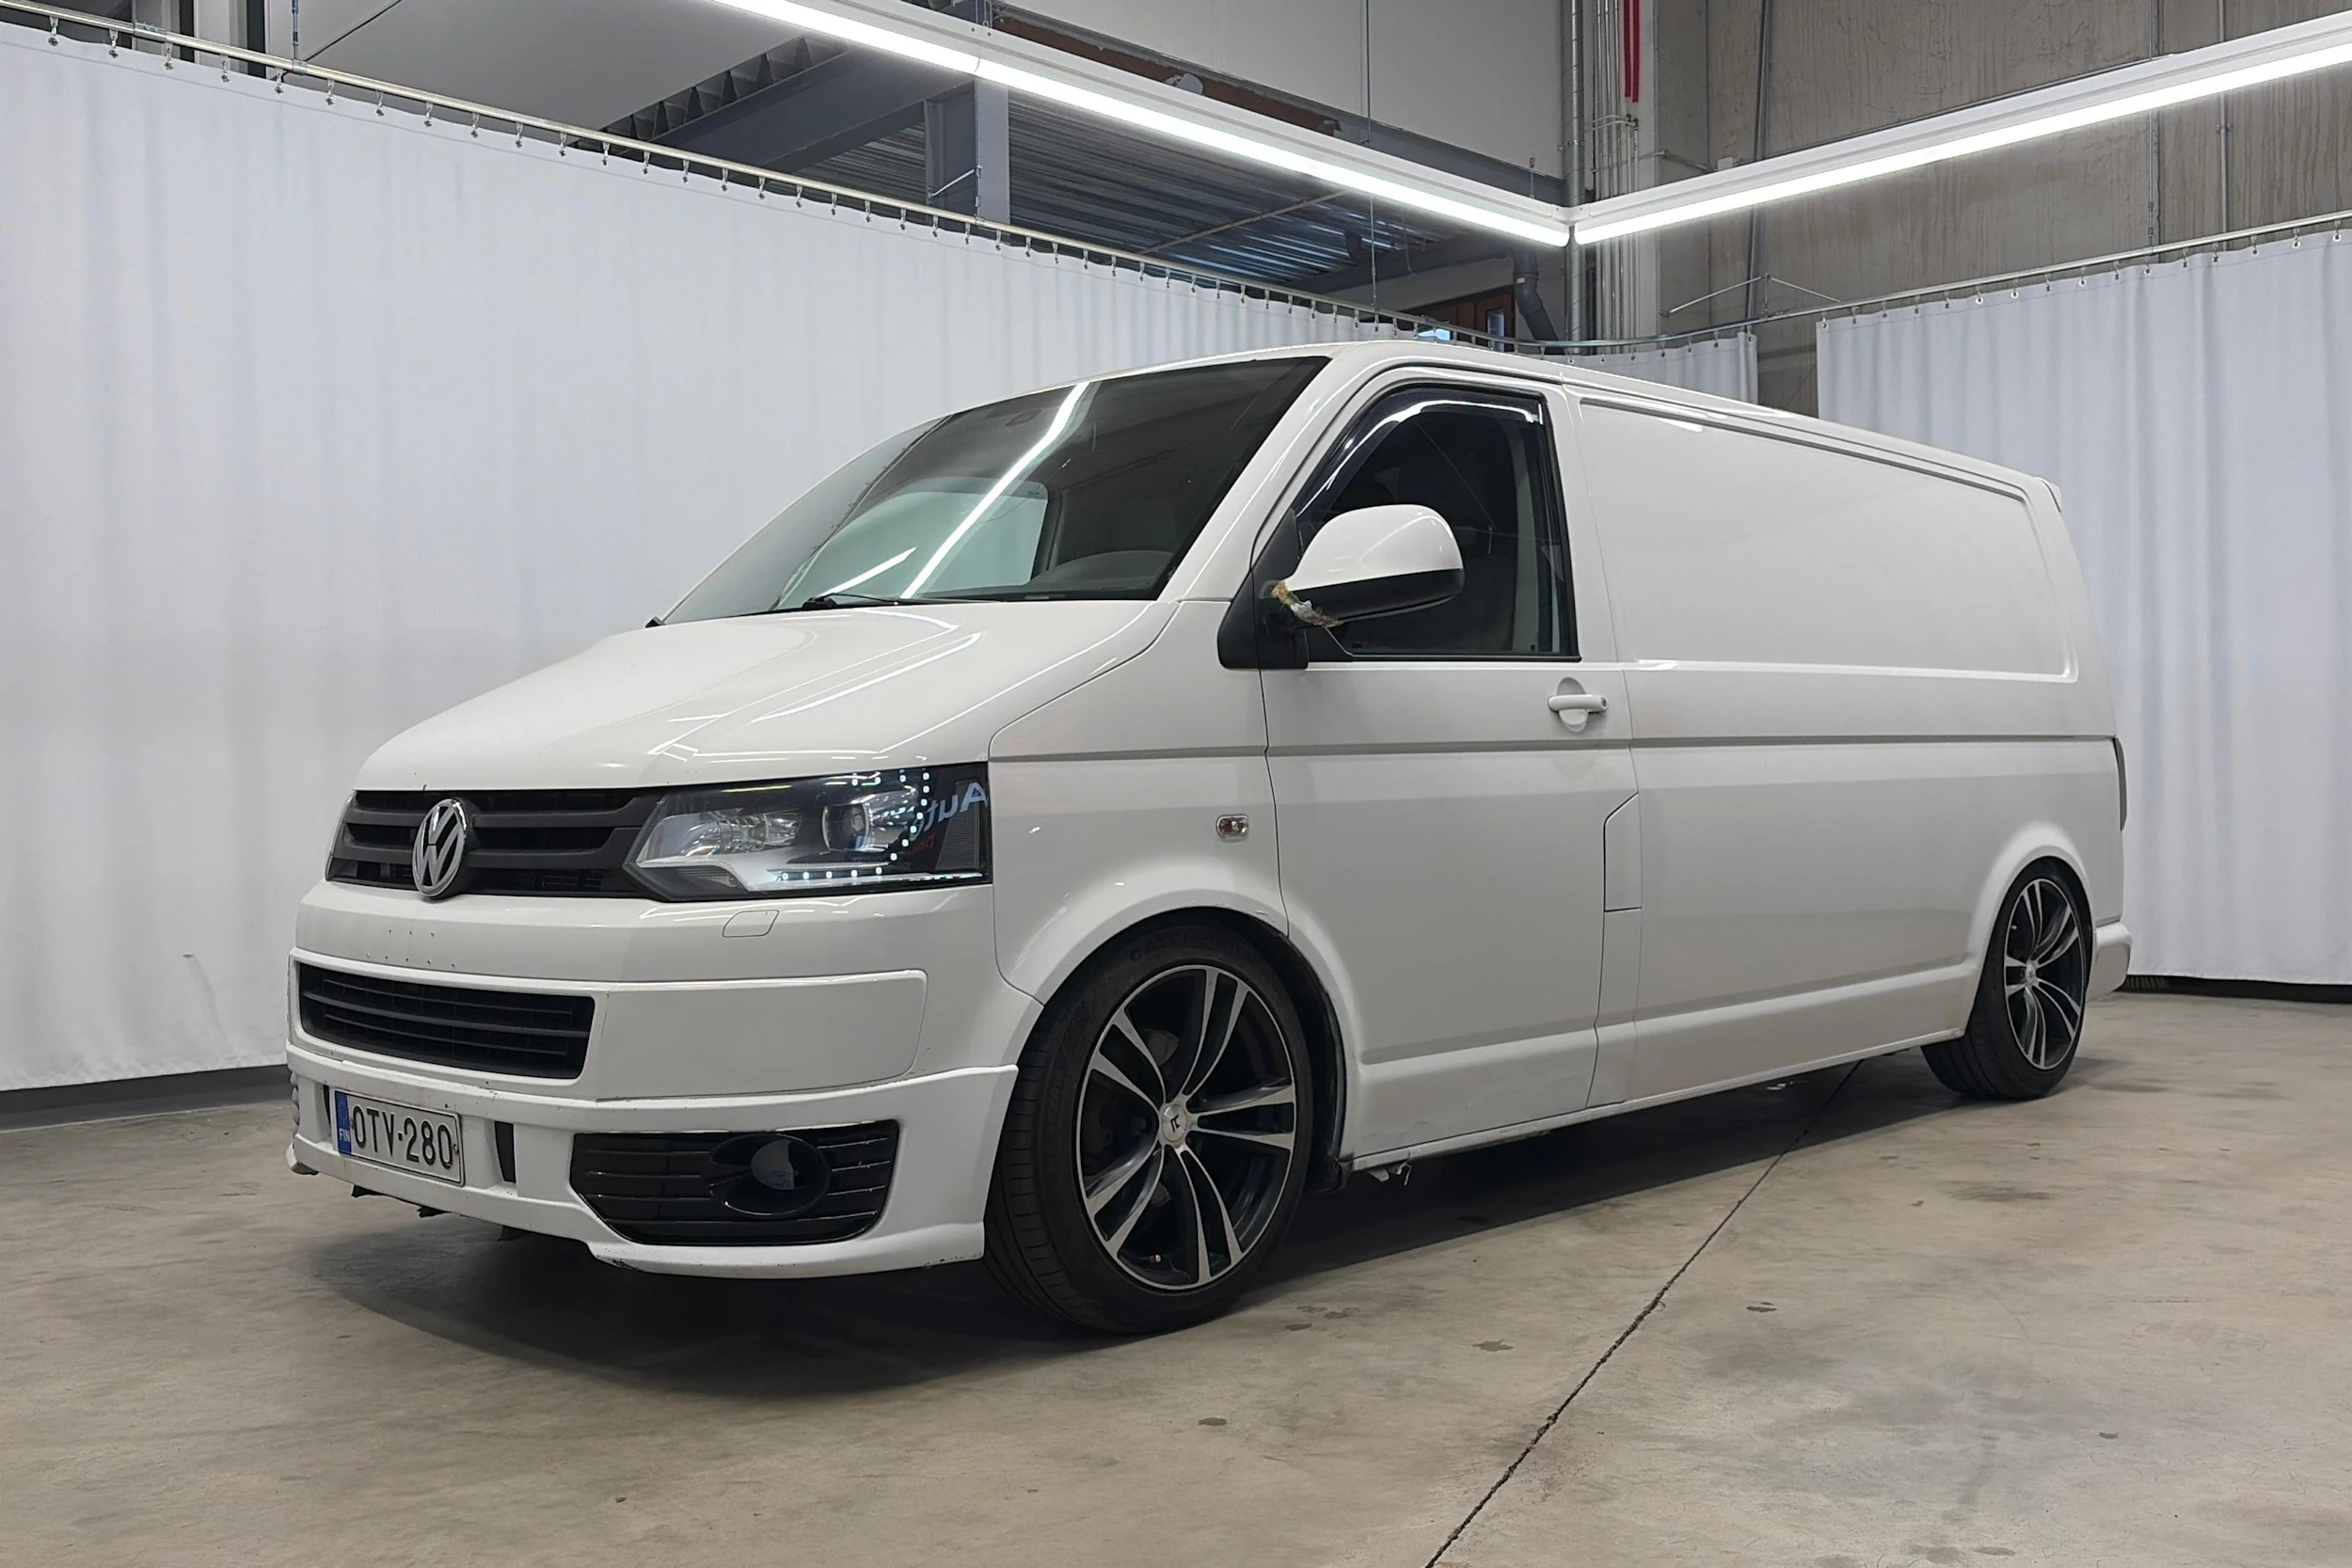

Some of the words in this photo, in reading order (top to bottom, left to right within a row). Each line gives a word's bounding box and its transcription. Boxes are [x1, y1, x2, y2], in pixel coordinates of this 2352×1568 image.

[414, 800, 464, 895] VW
[339, 1128, 351, 1143] FIN
[352, 1105, 453, 1169] OTV-280
